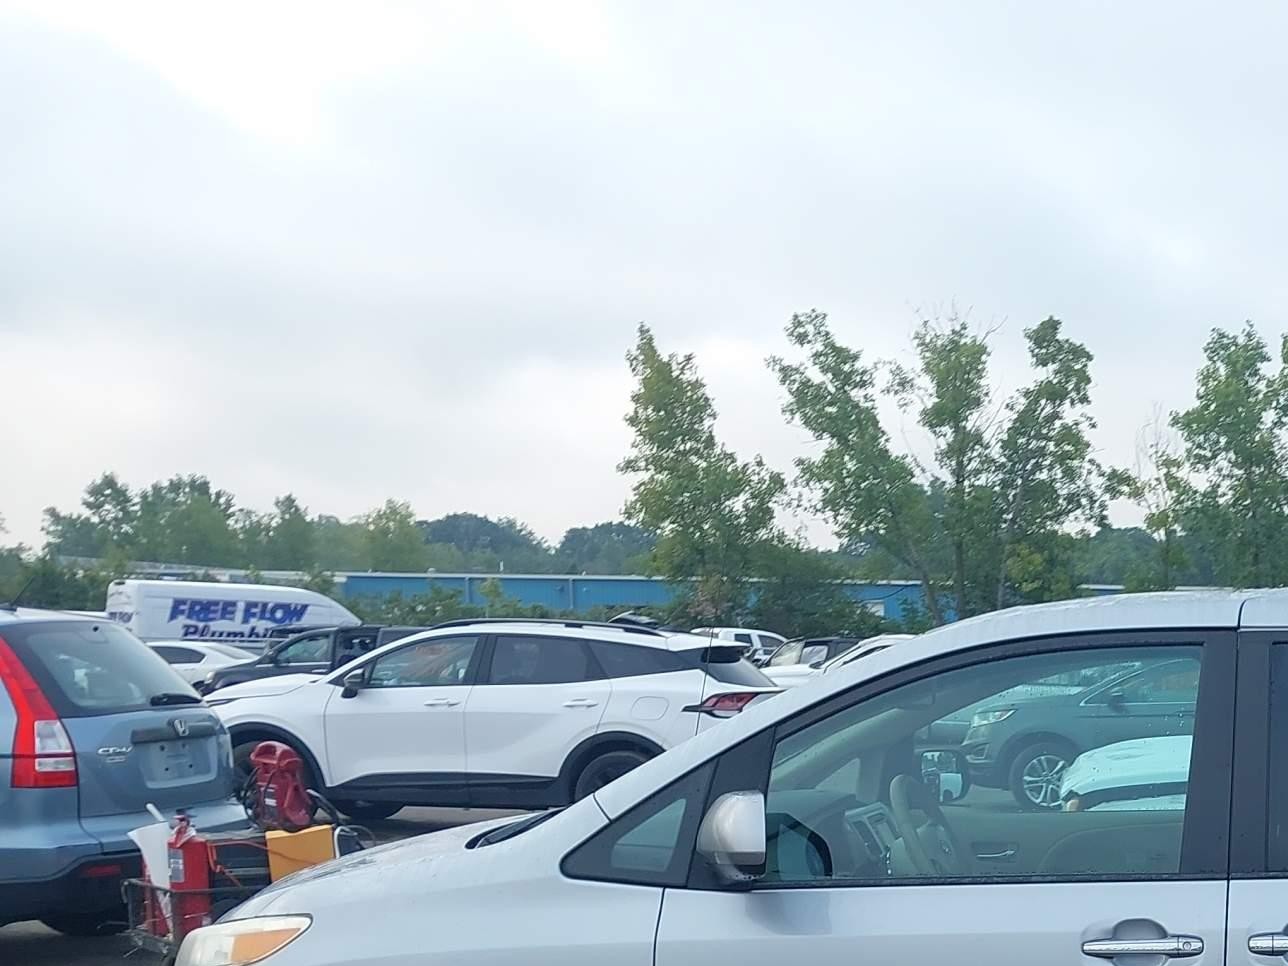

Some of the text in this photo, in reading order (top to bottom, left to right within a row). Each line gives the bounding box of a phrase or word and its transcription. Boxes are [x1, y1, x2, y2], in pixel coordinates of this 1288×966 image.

[168, 597, 309, 625] FREE FLOW
[181, 624, 272, 640] Plumbi
